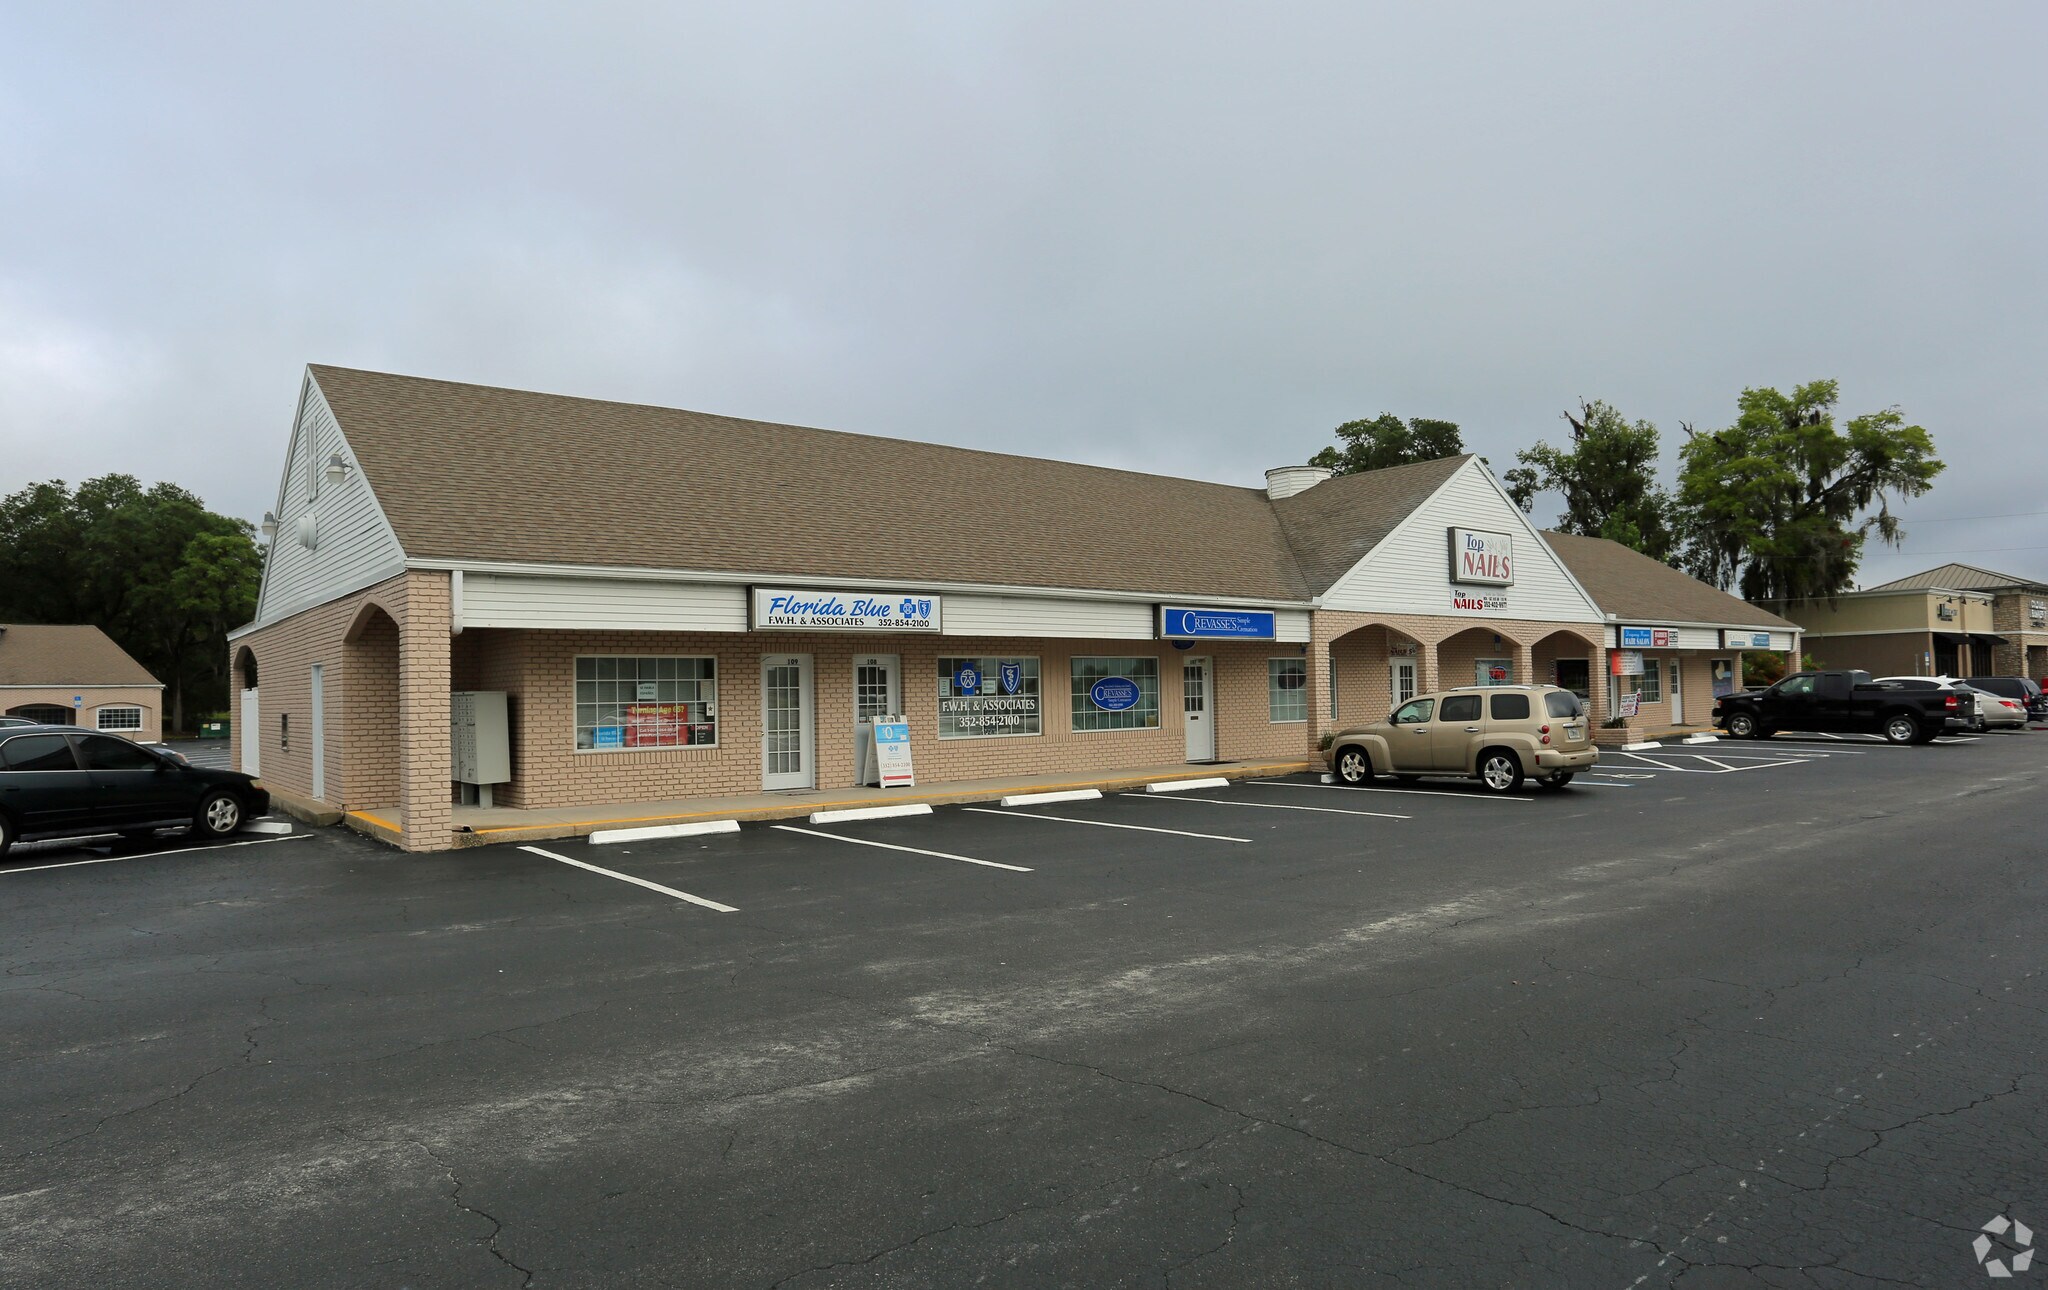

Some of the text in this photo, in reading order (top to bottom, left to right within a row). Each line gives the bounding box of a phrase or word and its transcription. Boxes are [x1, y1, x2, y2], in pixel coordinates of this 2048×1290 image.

[1465, 533, 1485, 553] Top
[1463, 551, 1510, 580] NAILS
[1454, 589, 1466, 598] Top
[769, 595, 891, 618] Florida Blue
[1453, 598, 1484, 610] NAILS
[768, 616, 865, 626] F.W.H. & ASSOCIATES
[878, 618, 930, 628] 352-854-2100
[1182, 611, 1237, 634] CREVASSE'S
[659, 706, 672, 715] Age
[942, 699, 1035, 711] F.W.H. & ASSOCIATES
[959, 714, 1020, 728] 352-854-2100
